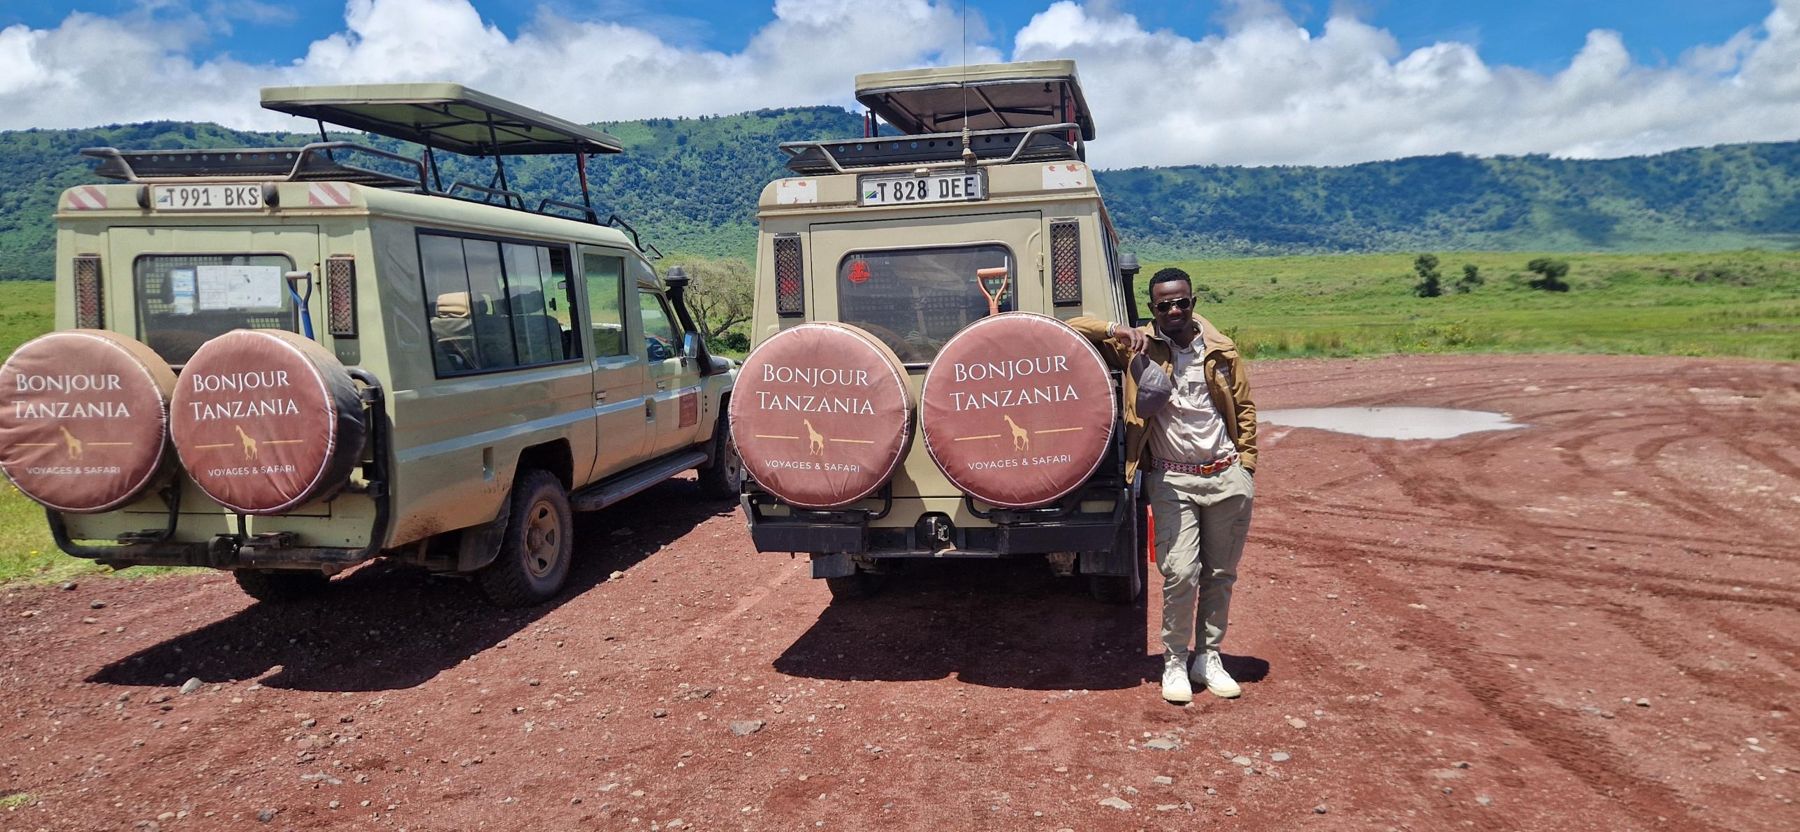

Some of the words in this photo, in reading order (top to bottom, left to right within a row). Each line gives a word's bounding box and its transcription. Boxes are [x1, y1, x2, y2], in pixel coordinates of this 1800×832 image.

[166, 188, 175, 206] T
[180, 187, 212, 206] 991
[224, 187, 258, 206] BKS
[877, 182, 887, 202] T
[893, 180, 927, 201] 828
[939, 177, 975, 199] DEE
[763, 363, 869, 388] BONJOUR
[954, 355, 1070, 382] BONJOUR
[16, 373, 122, 394] BONJOUR
[193, 370, 291, 393] BONJOUR
[755, 390, 876, 415] TANZANIA
[949, 384, 1080, 411] TANZANIA
[11, 400, 131, 419] TANZANIA
[189, 398, 300, 421] TANZANIA
[26, 466, 72, 475] VOYAGES
[75, 467, 82, 475] &
[84, 466, 121, 475] SAFARI
[208, 466, 250, 477] VOYAGES
[252, 466, 259, 474] &
[261, 464, 295, 474] SAFARI
[765, 459, 812, 470] VOYAGES
[814, 462, 822, 470] &
[824, 462, 860, 473] SAFARI
[968, 459, 1018, 470] VOYAGES
[1021, 457, 1029, 466] &
[1032, 454, 1072, 465] SAFARI
